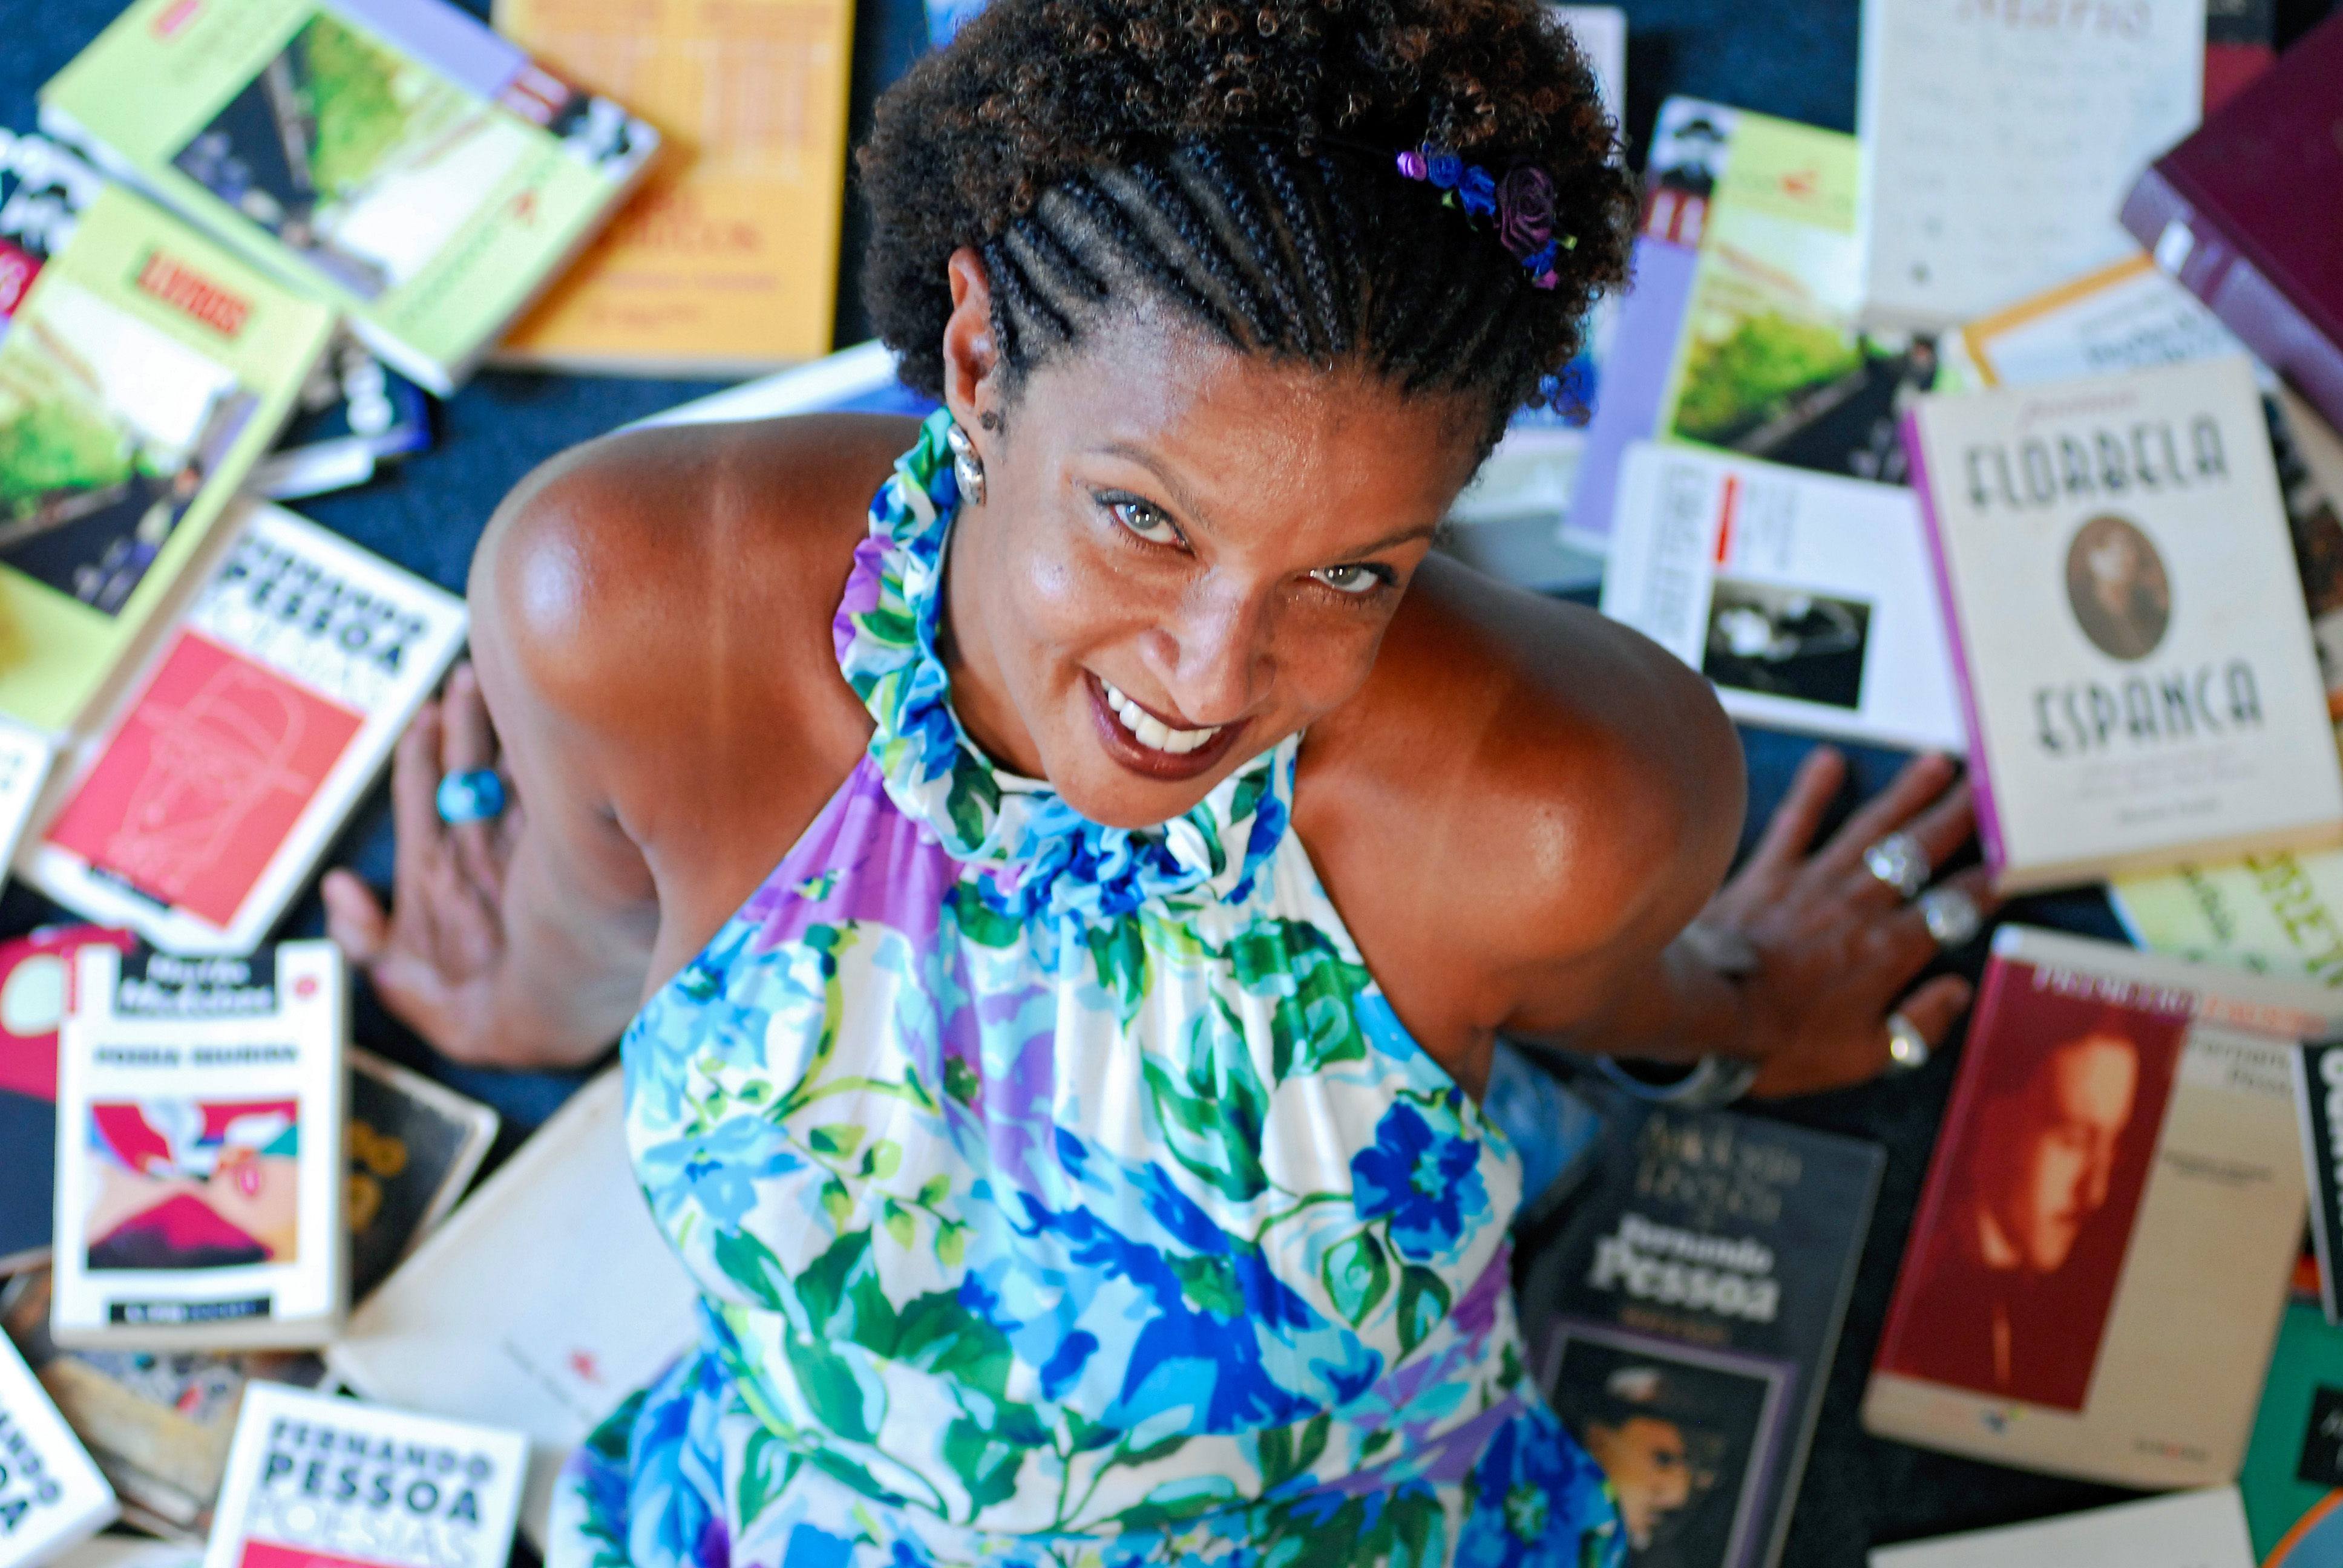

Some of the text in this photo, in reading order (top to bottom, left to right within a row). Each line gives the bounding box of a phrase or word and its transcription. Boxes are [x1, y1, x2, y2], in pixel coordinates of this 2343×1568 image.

[1966, 414, 2227, 509] FLORBELA
[221, 564, 402, 676] PESSOA
[2034, 662, 2263, 754] ESPANCA
[1590, 1236, 1780, 1321] Pessoa
[264, 1454, 479, 1526] PESSOA
[273, 1417, 493, 1481] FERNANDO
